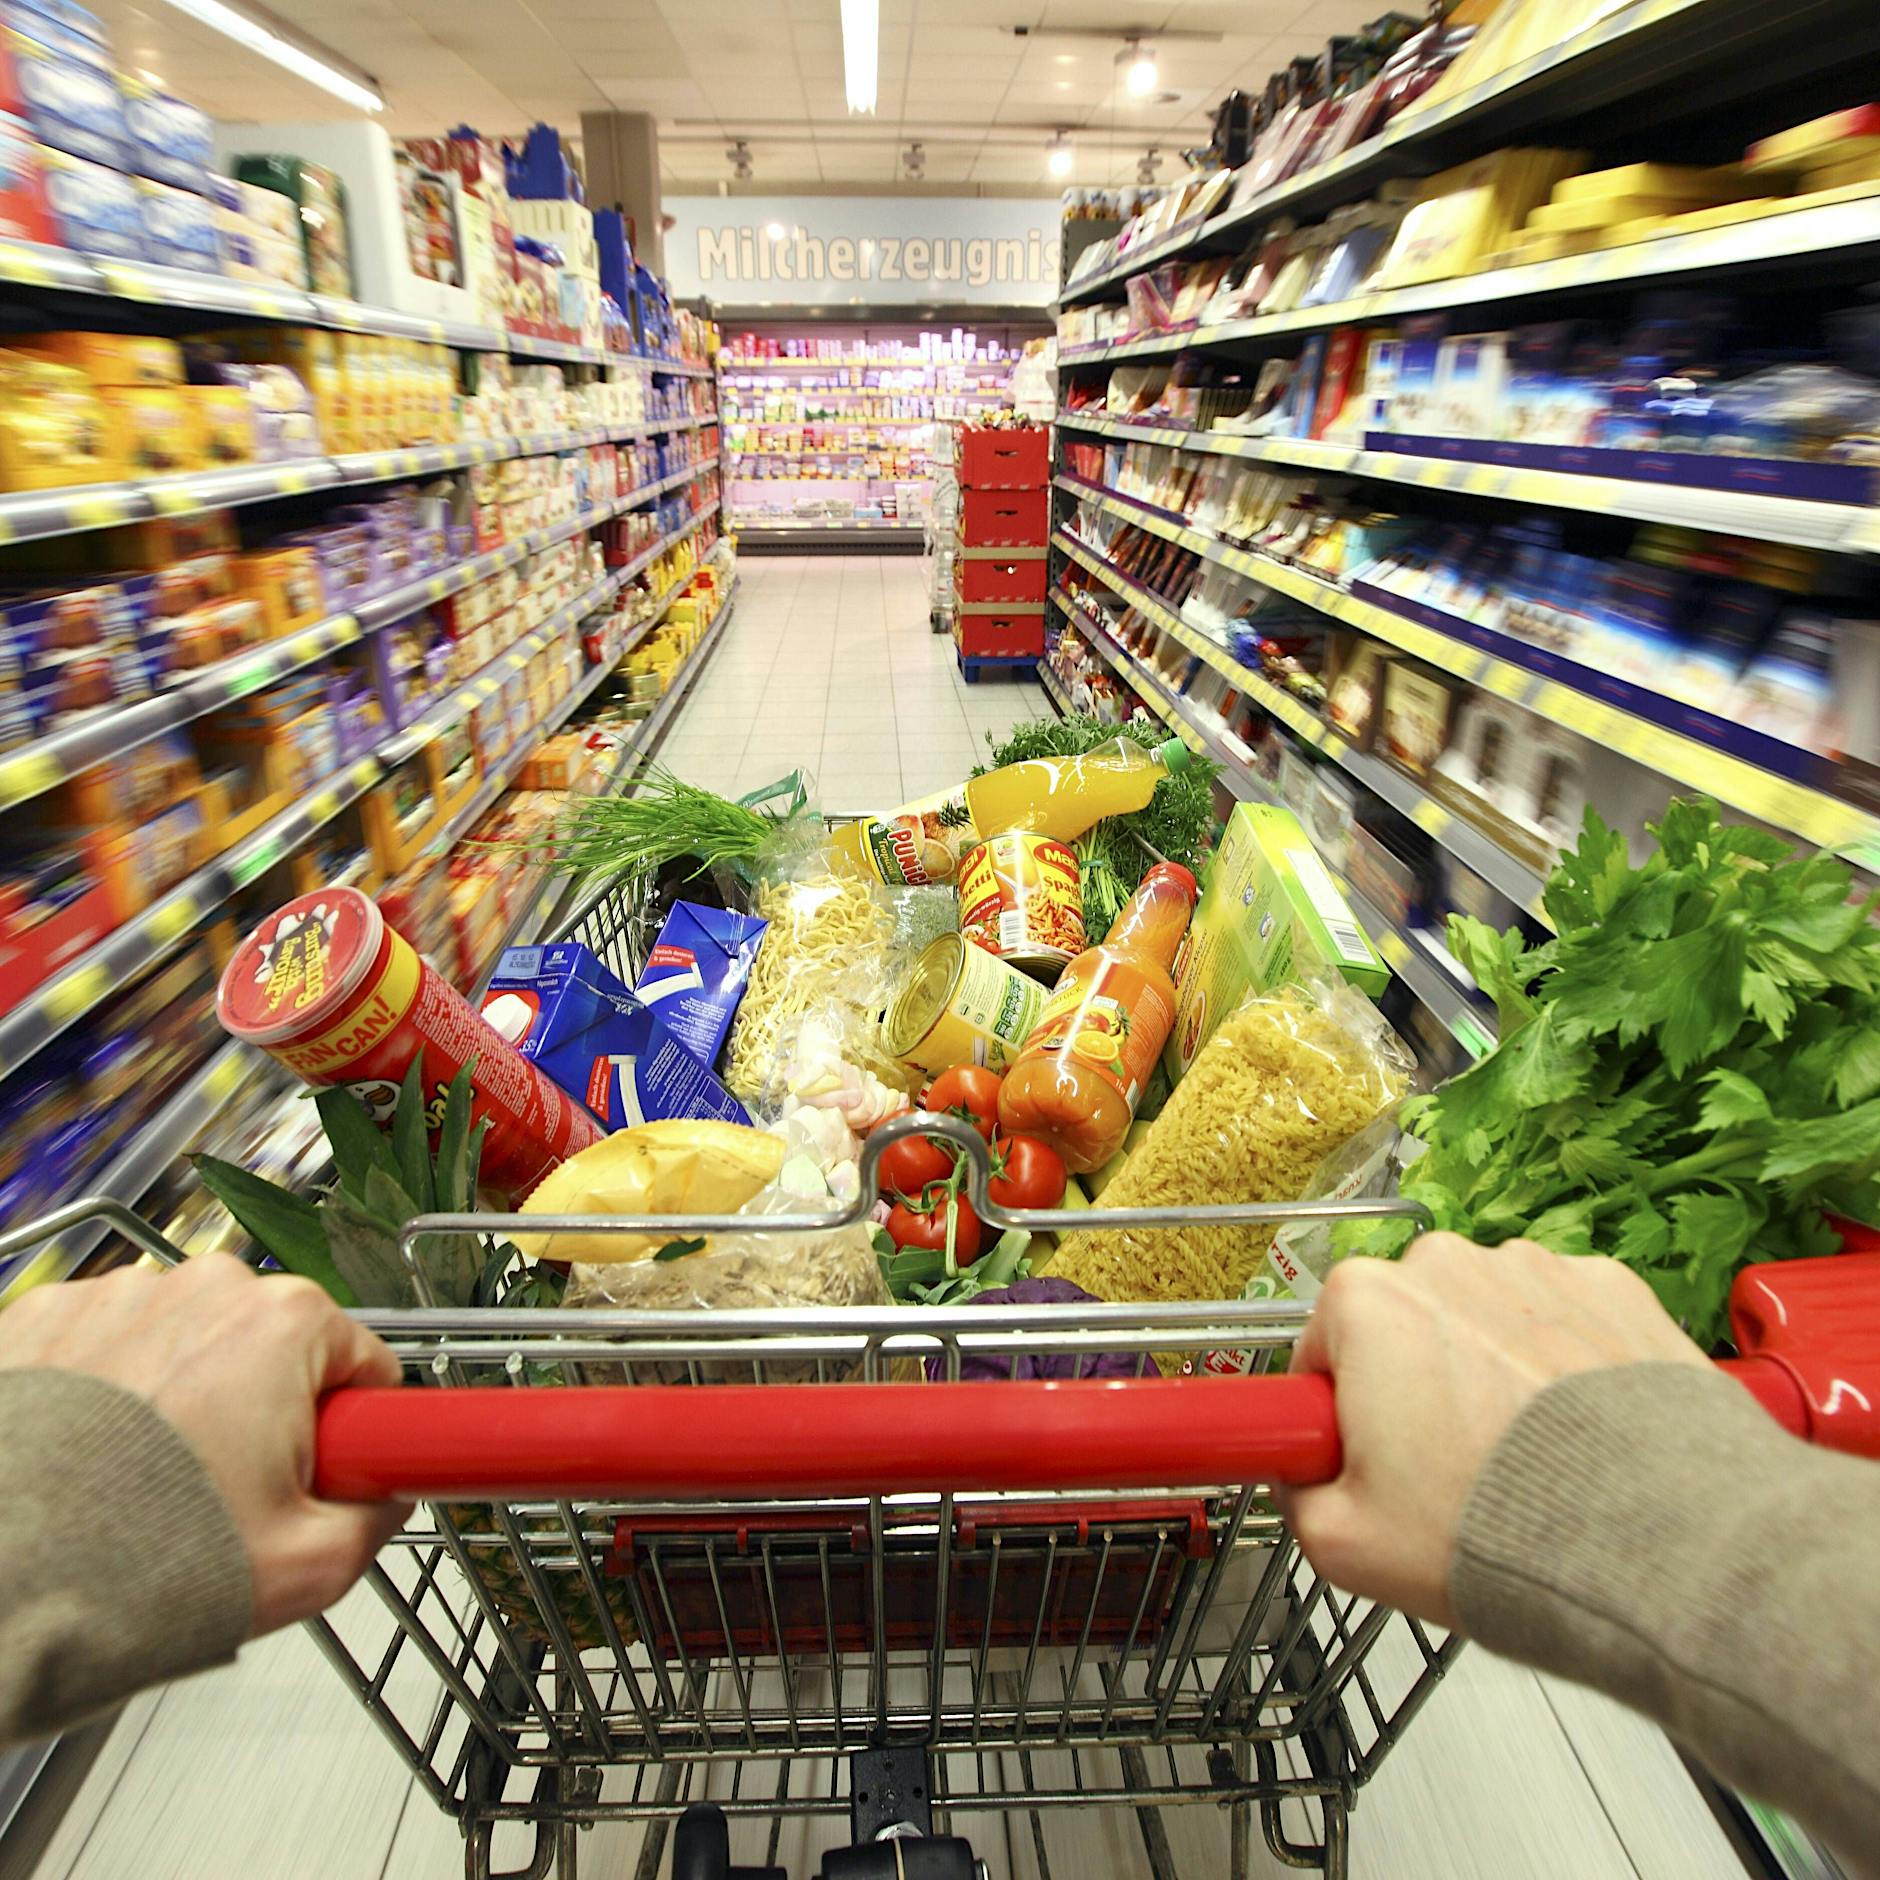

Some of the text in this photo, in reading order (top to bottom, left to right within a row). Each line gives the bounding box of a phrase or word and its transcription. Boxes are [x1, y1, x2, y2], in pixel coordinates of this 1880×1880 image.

[696, 227, 1060, 286] Milcherzeugnis
[878, 838, 895, 875] Tropical
[285, 995, 397, 1070] FAN CAN!
